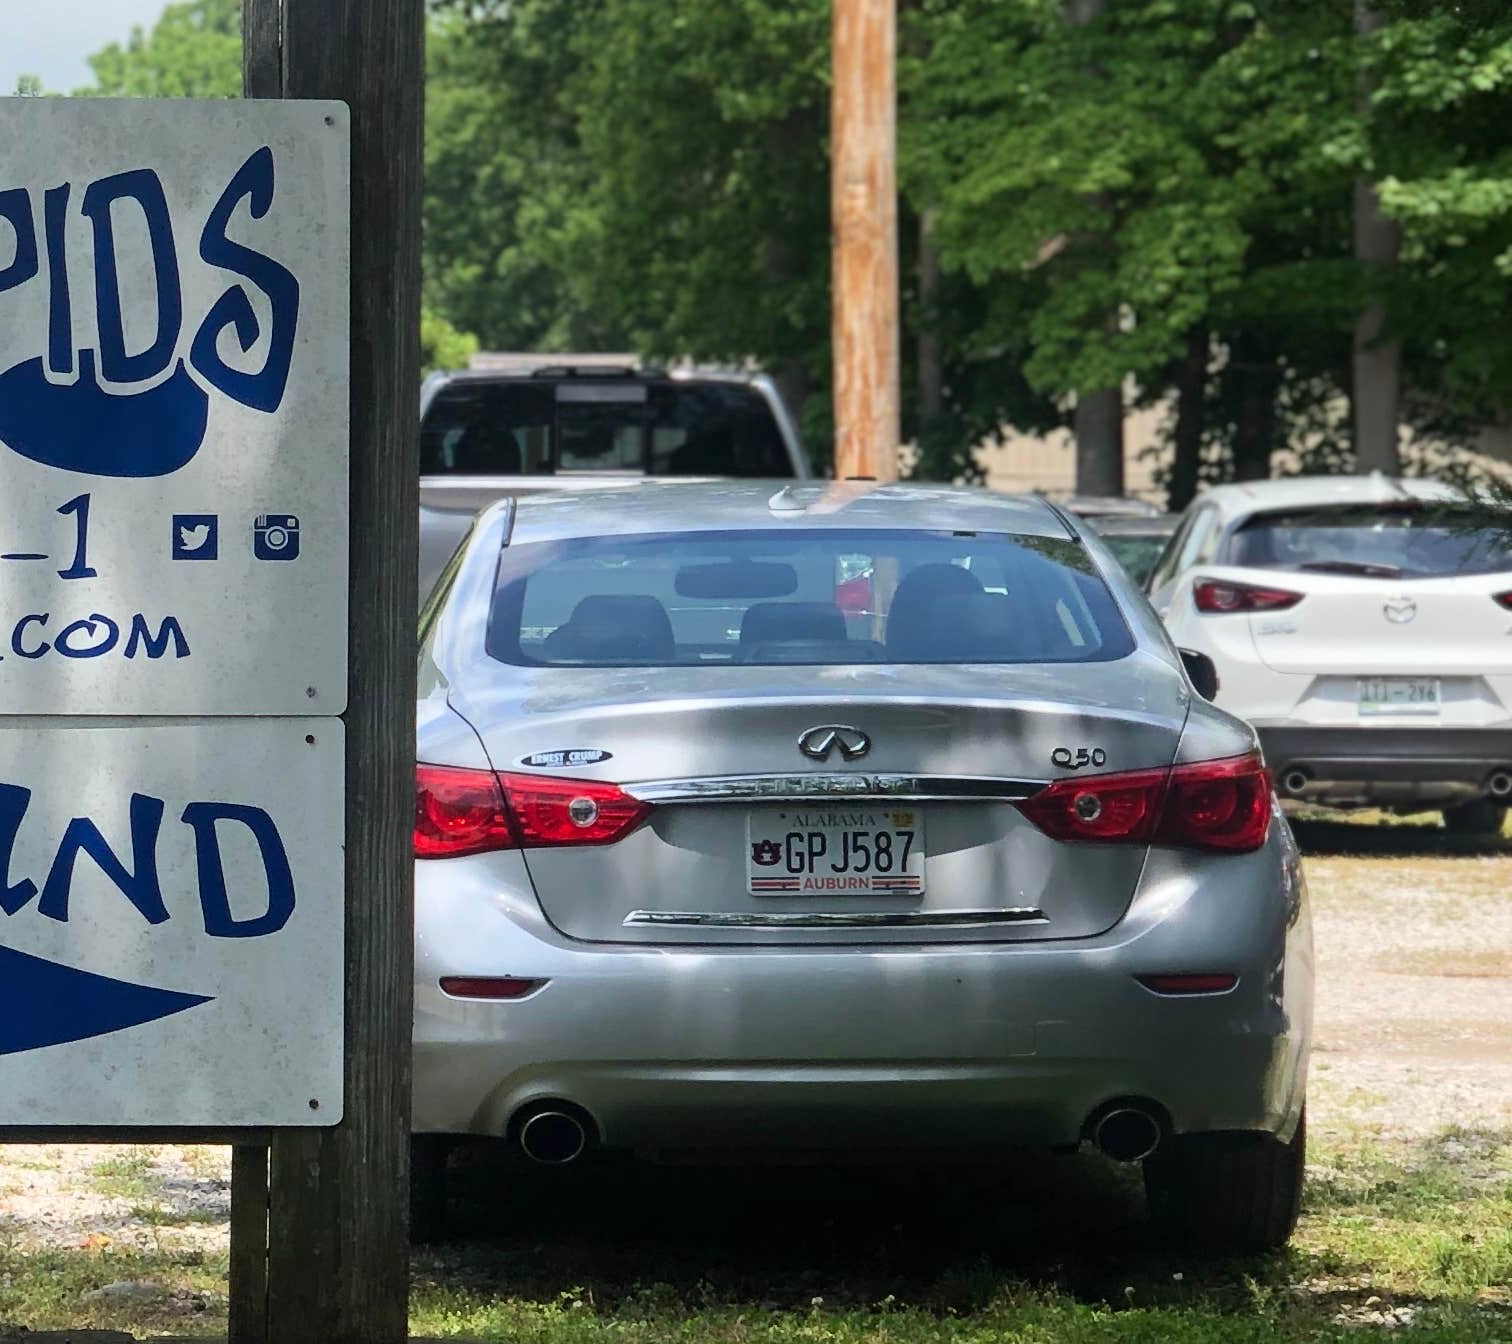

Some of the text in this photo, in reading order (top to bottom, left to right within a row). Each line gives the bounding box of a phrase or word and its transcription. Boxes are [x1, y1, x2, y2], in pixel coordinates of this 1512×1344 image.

[531, 752, 565, 765] ERNEST
[568, 750, 603, 762] CRUMP
[1051, 748, 1107, 770] Q50
[792, 814, 876, 828] ALABAMA
[803, 877, 870, 890] AUBURN
